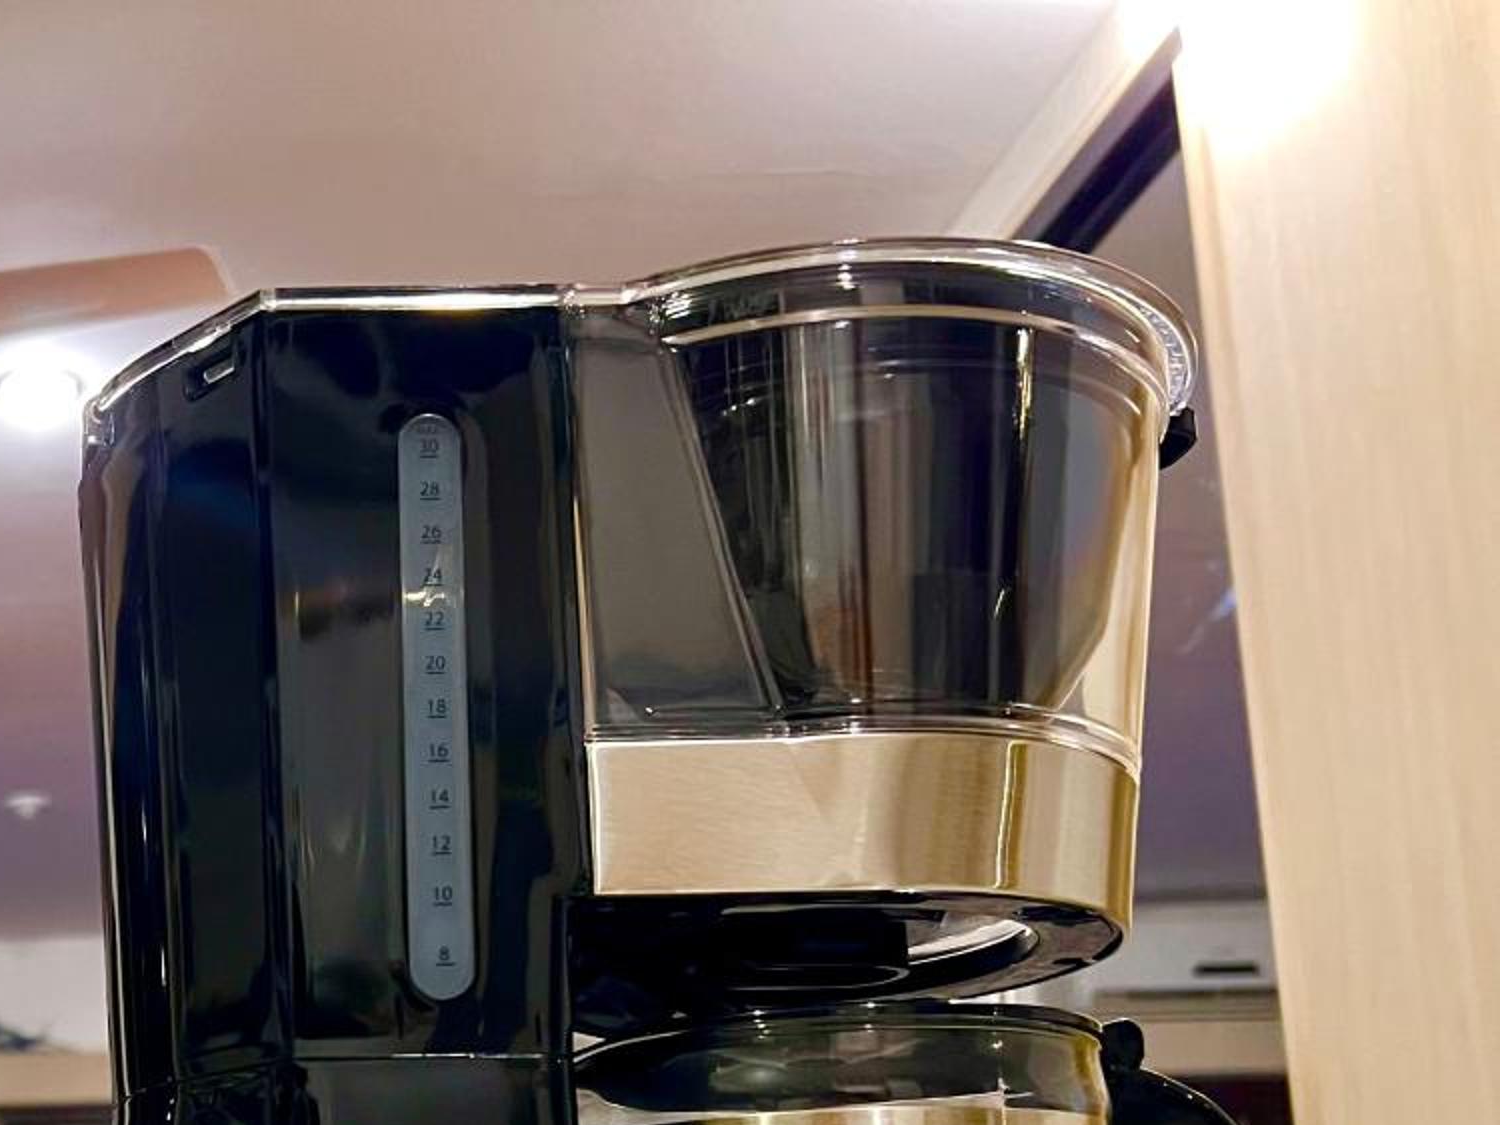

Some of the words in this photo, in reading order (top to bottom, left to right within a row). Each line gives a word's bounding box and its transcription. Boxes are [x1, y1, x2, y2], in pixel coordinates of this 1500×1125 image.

[420, 481, 440, 497] 28
[421, 525, 442, 540] 26
[423, 568, 443, 583] 24
[425, 612, 444, 627] 22
[426, 656, 446, 670] 20
[428, 700, 447, 715] 18
[429, 744, 449, 759] 16
[430, 789, 449, 804] 14
[432, 835, 451, 850] 12
[434, 886, 453, 901] 10
[438, 946, 450, 962] 8
